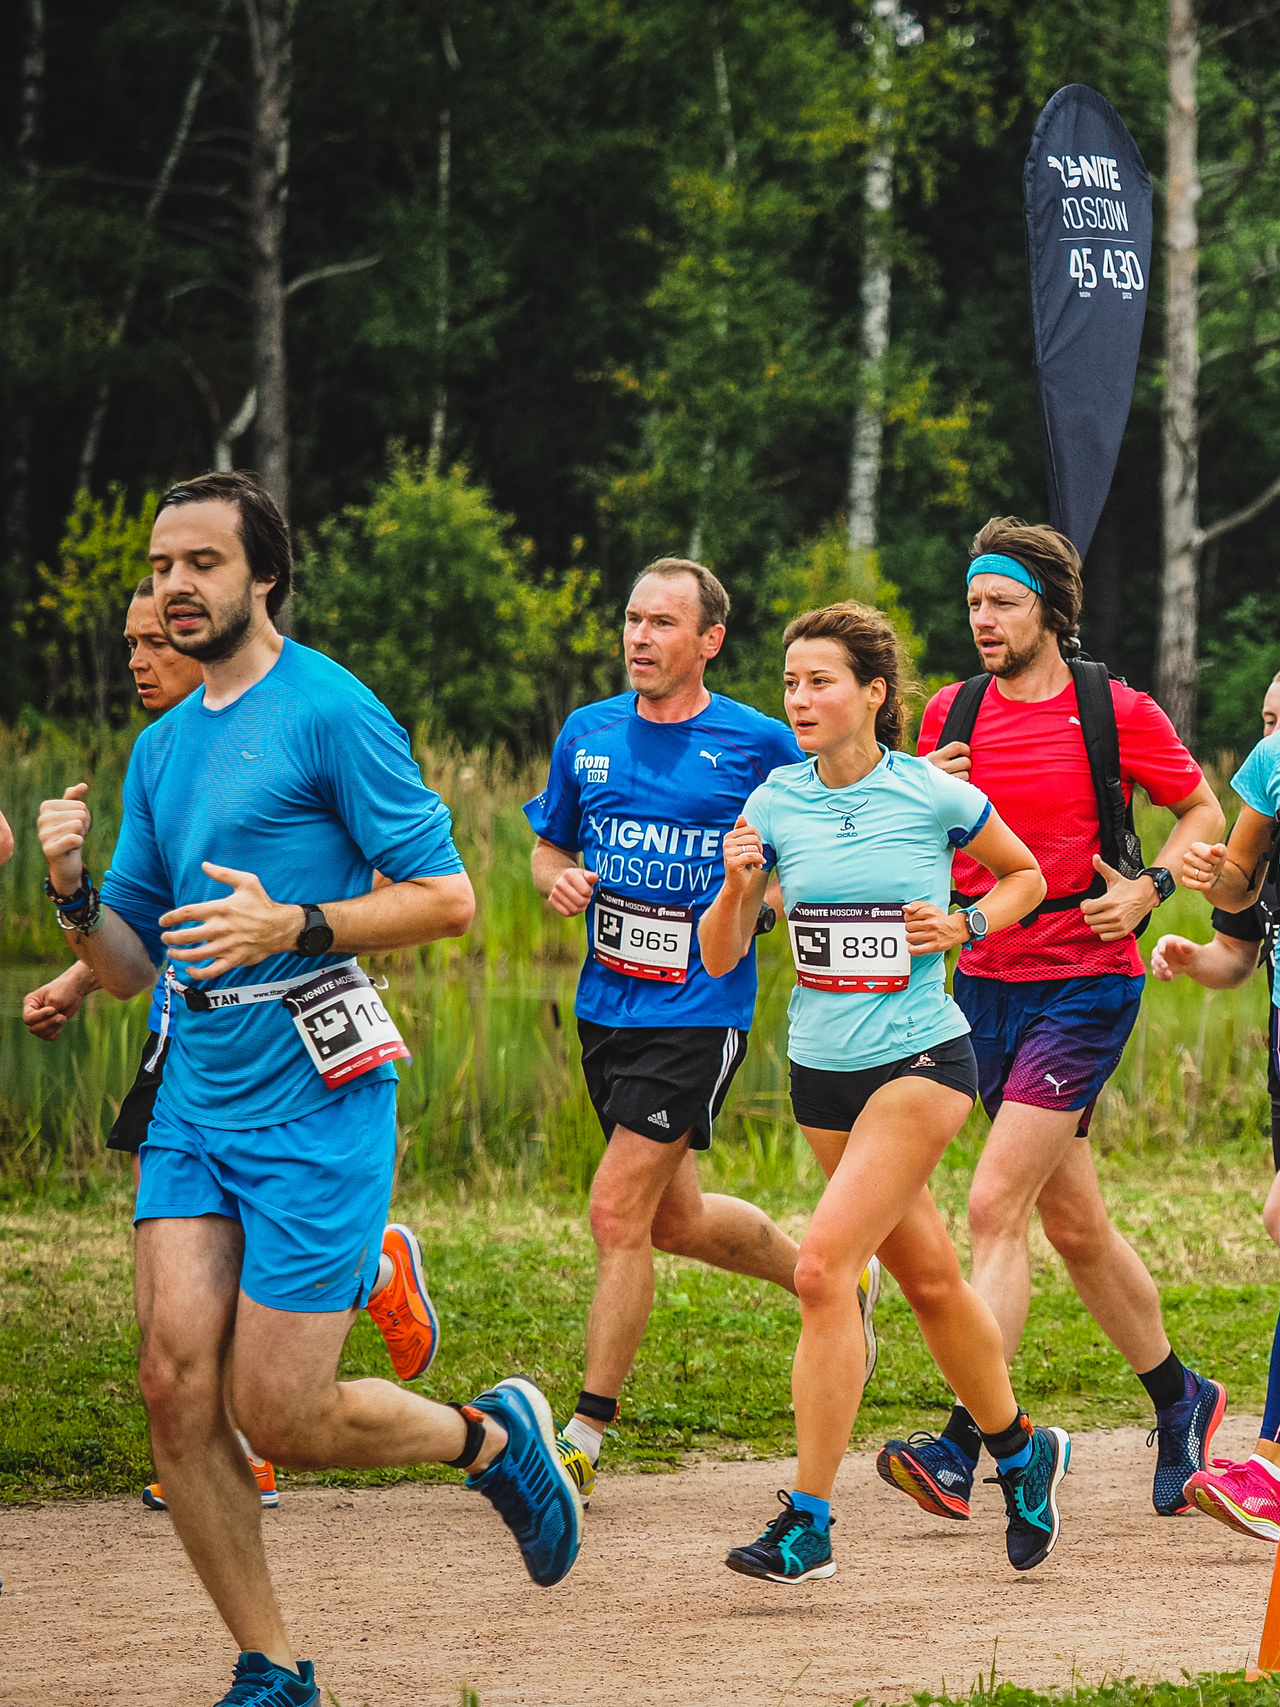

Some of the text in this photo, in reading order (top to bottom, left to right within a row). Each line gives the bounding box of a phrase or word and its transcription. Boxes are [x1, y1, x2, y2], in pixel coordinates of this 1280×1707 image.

[1069, 247, 1145, 291] 45 4.30
[588, 770, 607, 783] 10k
[608, 818, 721, 858] IGNITE
[595, 850, 714, 892] MOSCOW
[624, 900, 652, 913] MOSCOW
[800, 907, 829, 918] IGNITE
[829, 908, 864, 917] MOSCOW
[629, 927, 679, 953] 965
[842, 936, 898, 959] 830
[300, 981, 337, 1002] IGNITE
